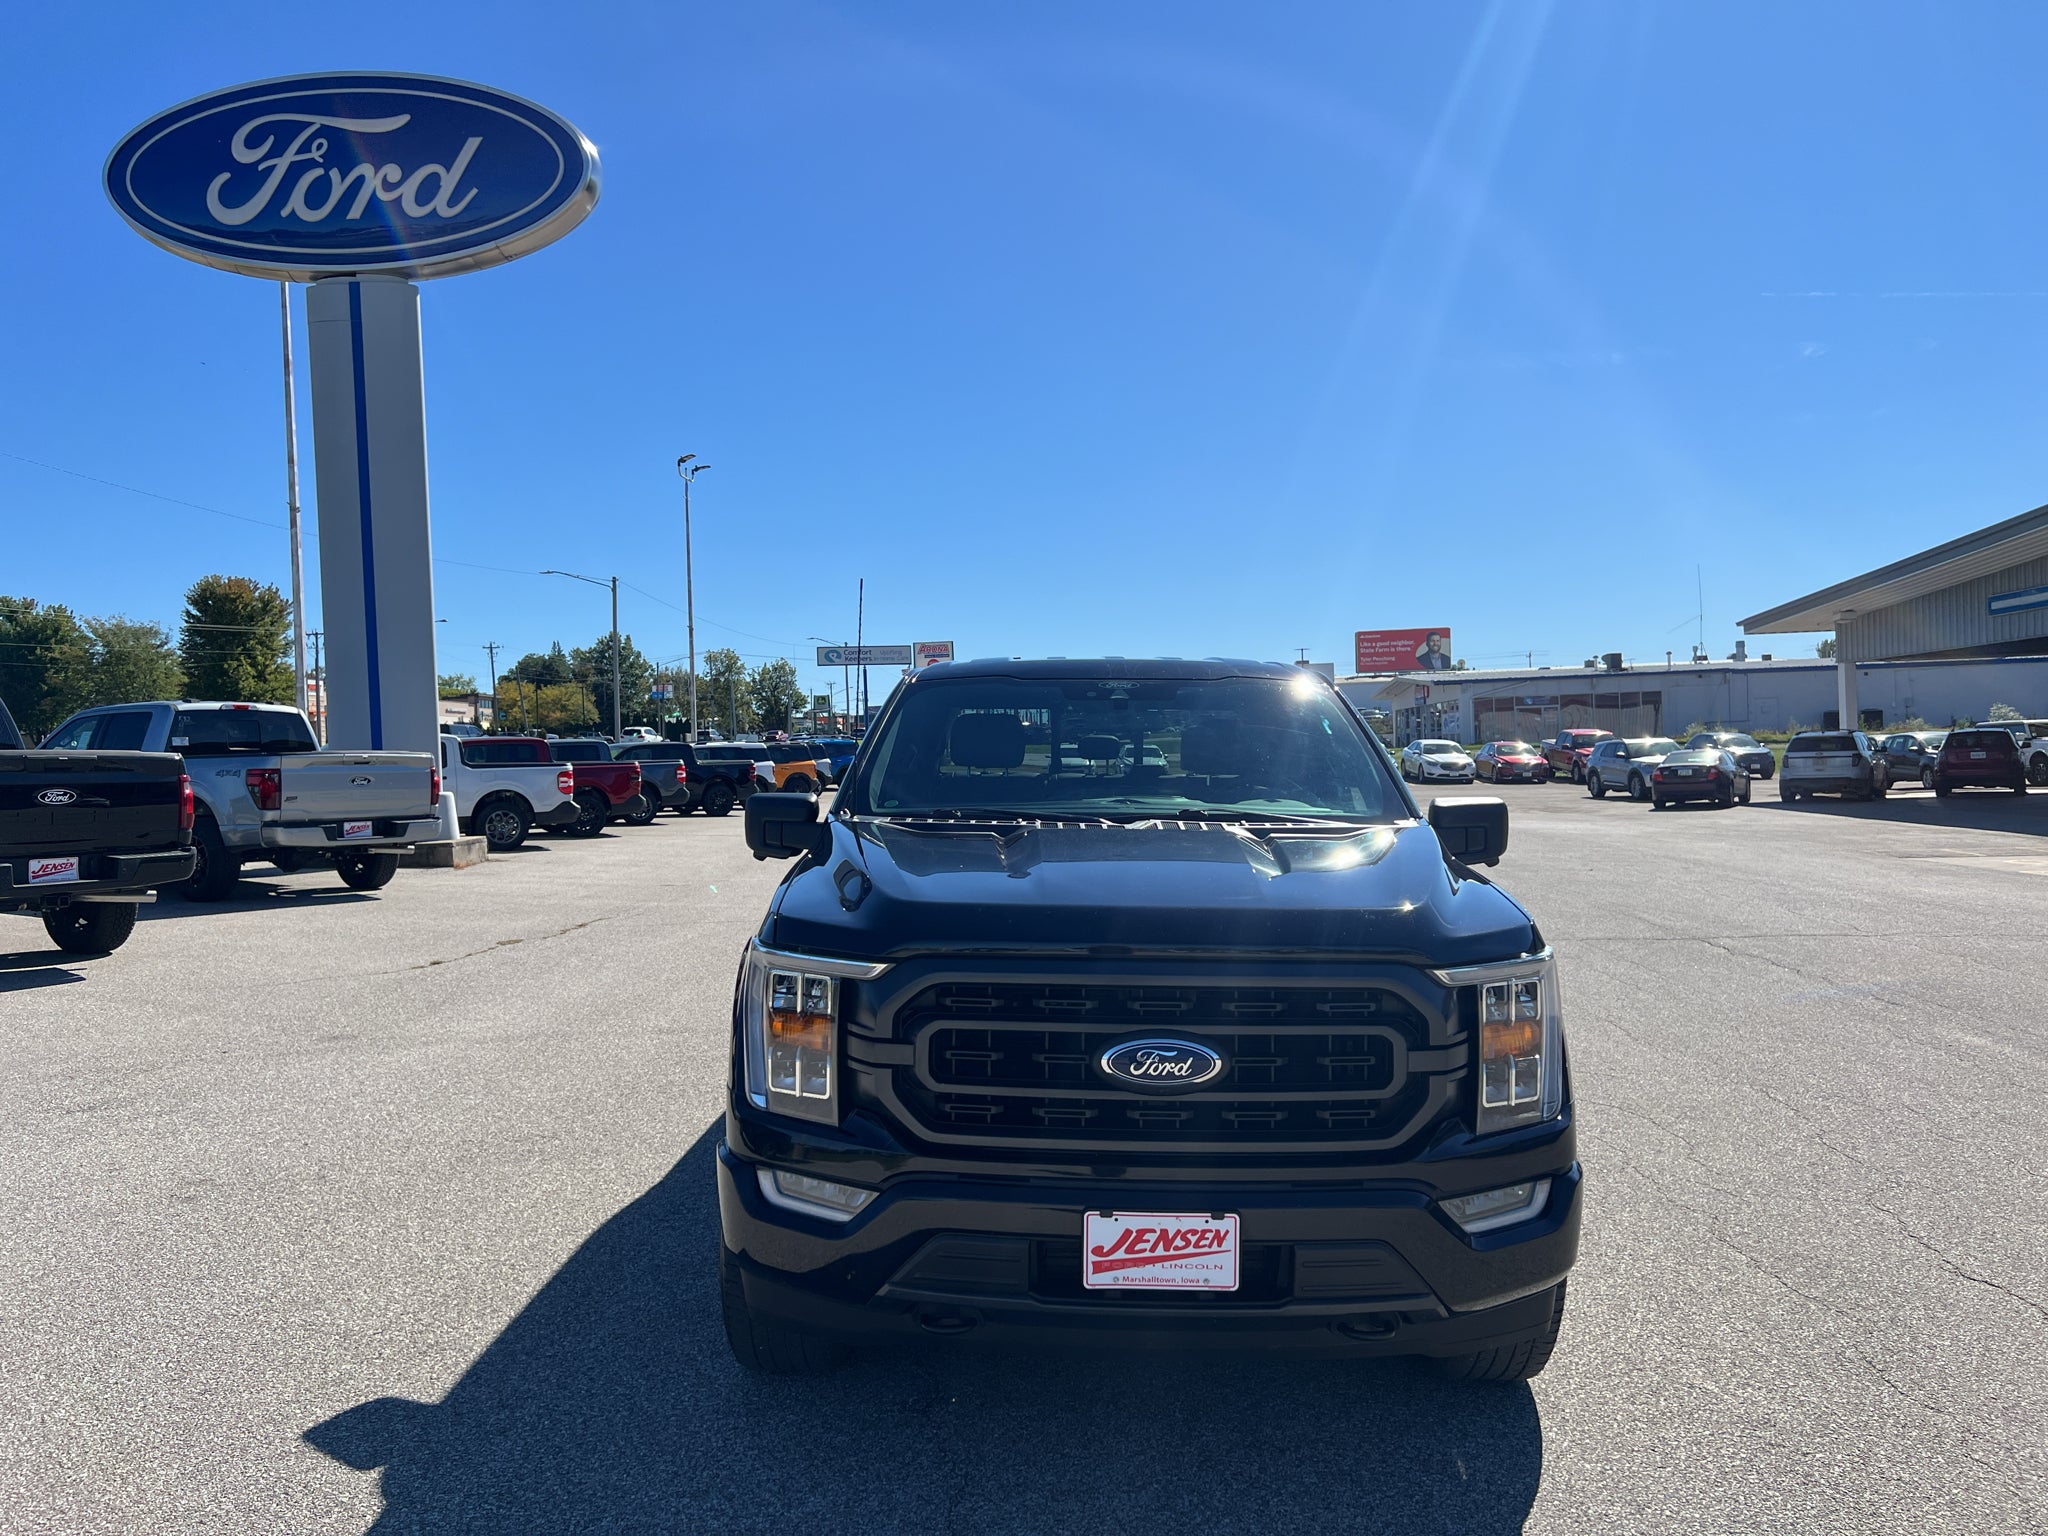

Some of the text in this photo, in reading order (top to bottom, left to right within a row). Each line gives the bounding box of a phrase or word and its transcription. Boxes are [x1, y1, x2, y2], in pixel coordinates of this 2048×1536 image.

[206, 113, 483, 225] Ford
[44, 791, 70, 802] Ford
[31, 862, 75, 874] JENSEN
[1130, 1049, 1193, 1076] Ford
[1091, 1228, 1230, 1258] JENSEN
[1122, 1276, 1200, 1284] Marshalltown, Iowa
